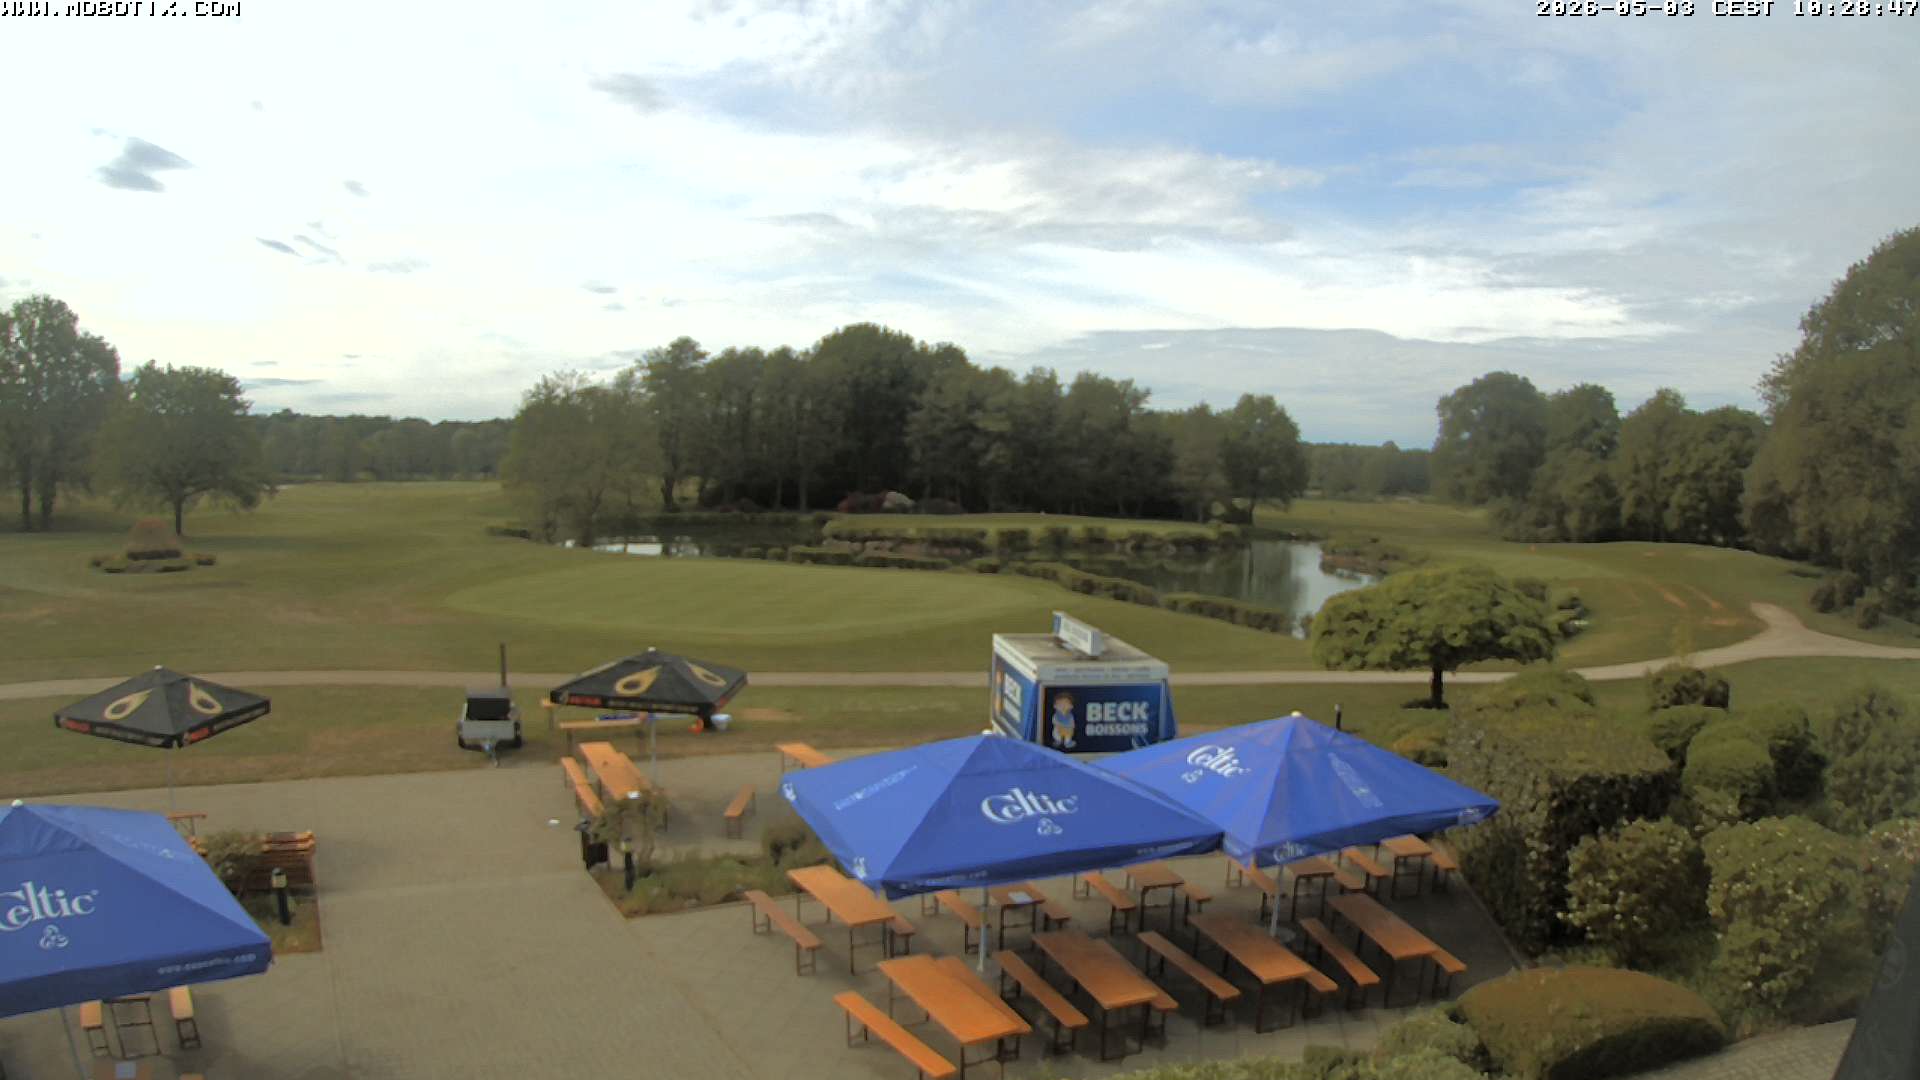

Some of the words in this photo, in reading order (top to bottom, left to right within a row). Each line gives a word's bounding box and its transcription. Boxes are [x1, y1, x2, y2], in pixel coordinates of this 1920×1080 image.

[1085, 701, 1149, 722] BECK
[1085, 723, 1148, 736] BOISSONS
[1187, 745, 1249, 778] Celtic
[981, 787, 1078, 823] Celtic
